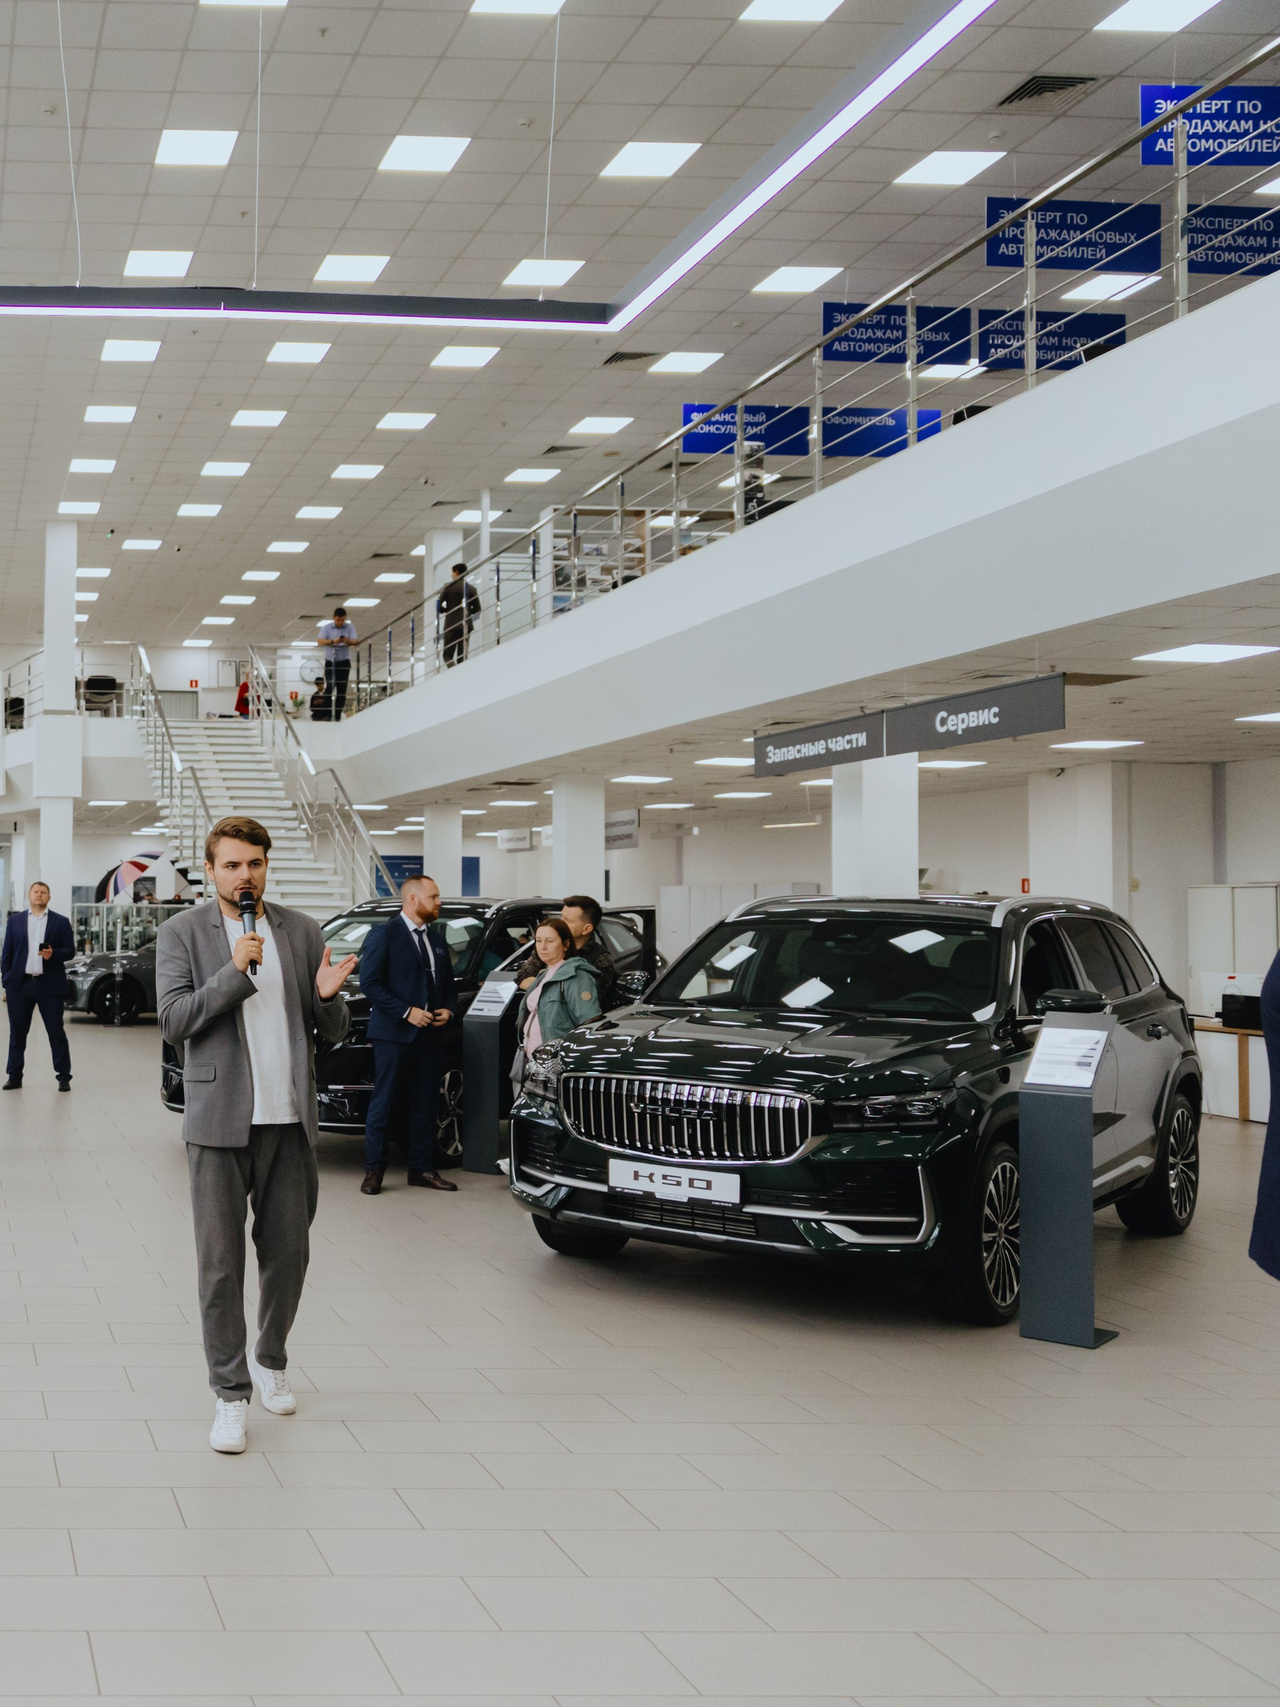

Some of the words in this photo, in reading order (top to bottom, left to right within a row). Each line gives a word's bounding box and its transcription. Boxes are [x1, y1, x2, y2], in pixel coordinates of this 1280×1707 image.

[1236, 100, 1262, 114] ПО
[1067, 213, 1088, 225] ПО
[998, 227, 1082, 242] ПРОАЖАМ
[1085, 230, 1138, 244] НОВЫХ
[1187, 233, 1268, 248] ПРОДАЖАМ
[998, 243, 1107, 260] АВТМОБИЛЕЙ
[890, 315, 908, 327] ПО
[832, 341, 924, 355] АВТОМОБИЛЙ
[934, 706, 1001, 735] Сервис
[765, 738, 827, 764] Запасные
[827, 731, 868, 752] части
[632, 1169, 713, 1191] K50
